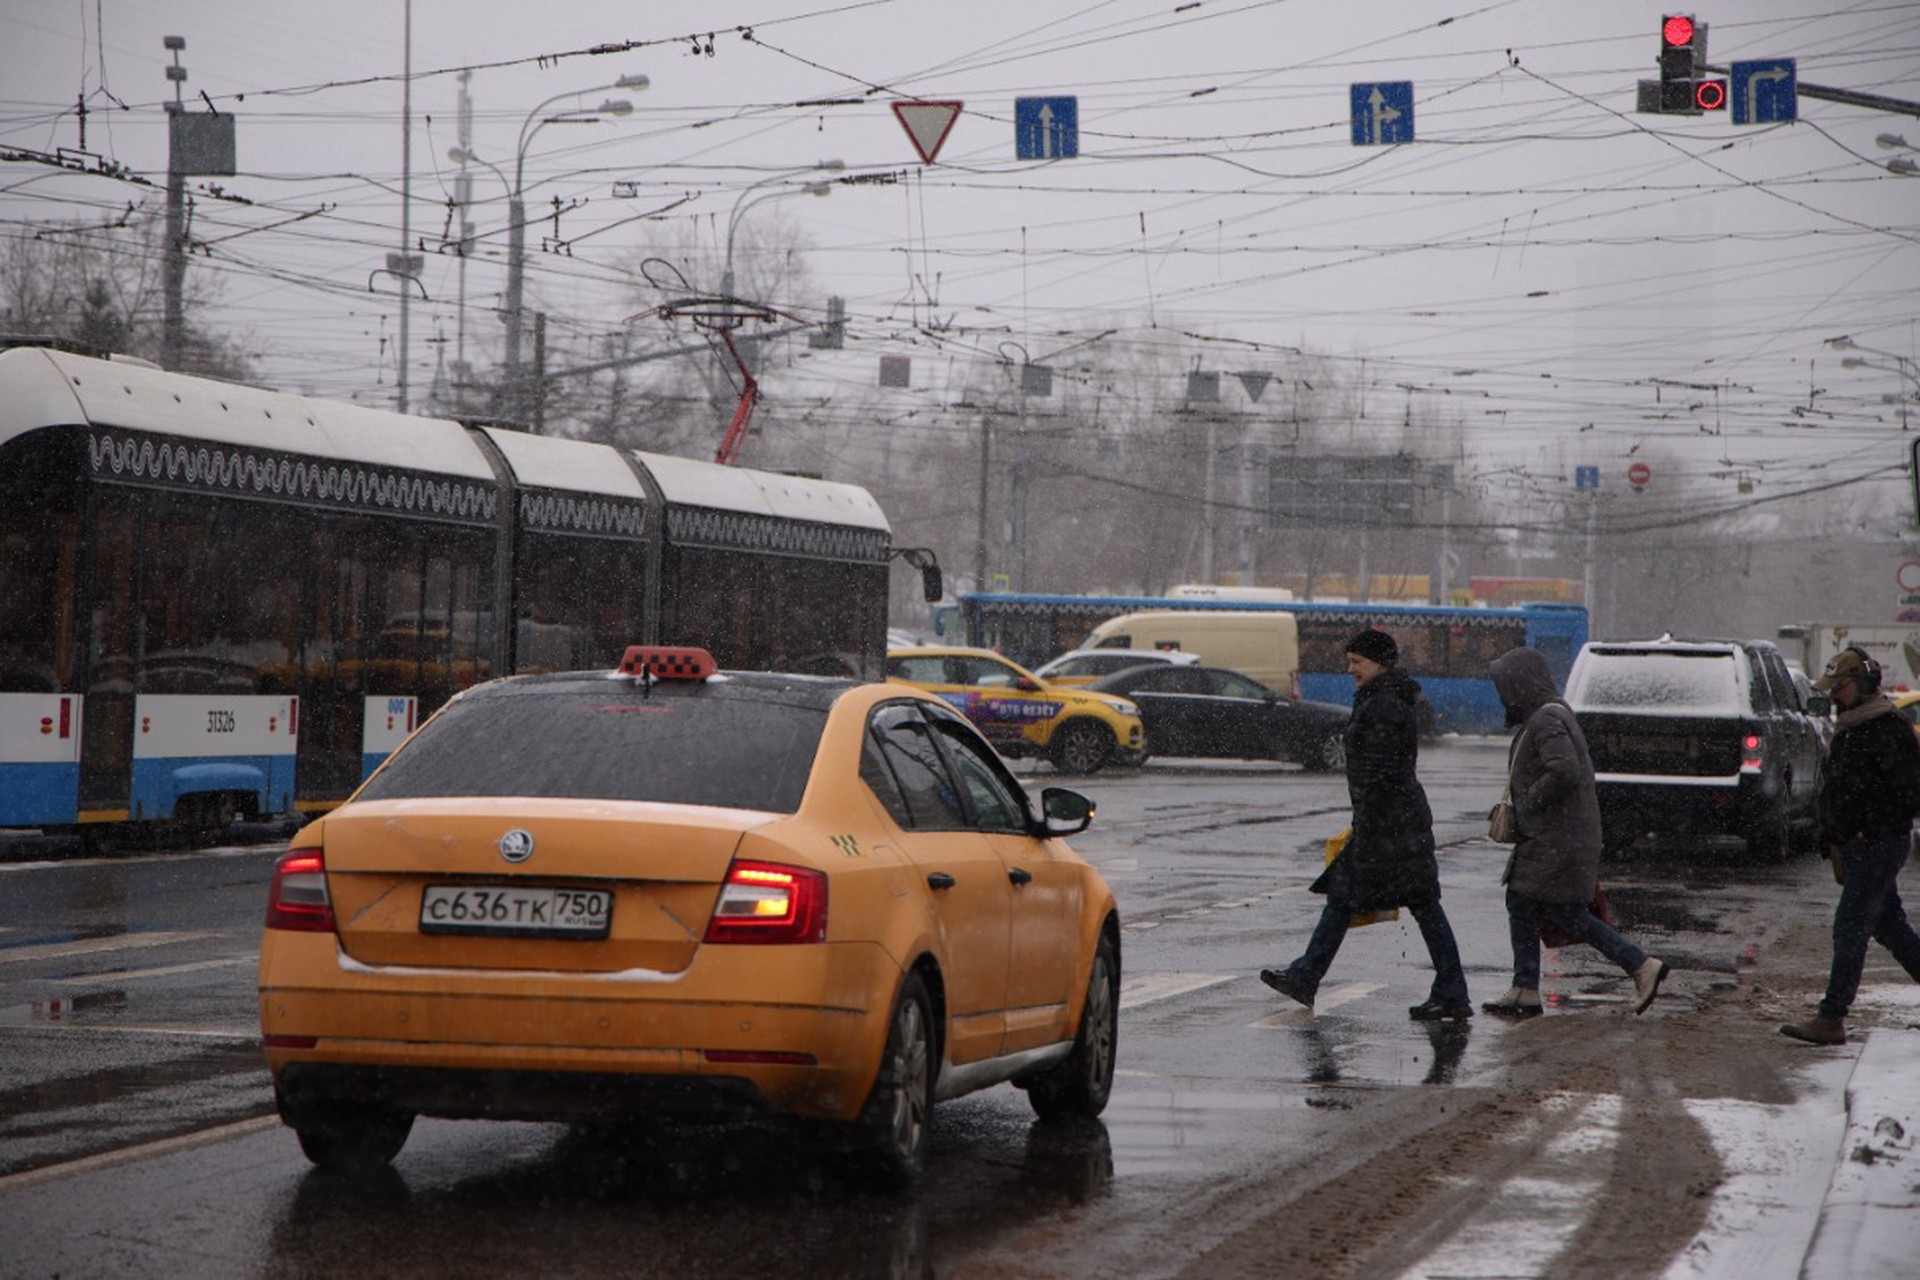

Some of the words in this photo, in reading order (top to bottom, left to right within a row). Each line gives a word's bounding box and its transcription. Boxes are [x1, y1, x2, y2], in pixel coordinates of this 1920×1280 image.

[207, 710, 235, 733] 31326
[430, 891, 548, 923] С636ТК
[557, 892, 602, 917] 750
